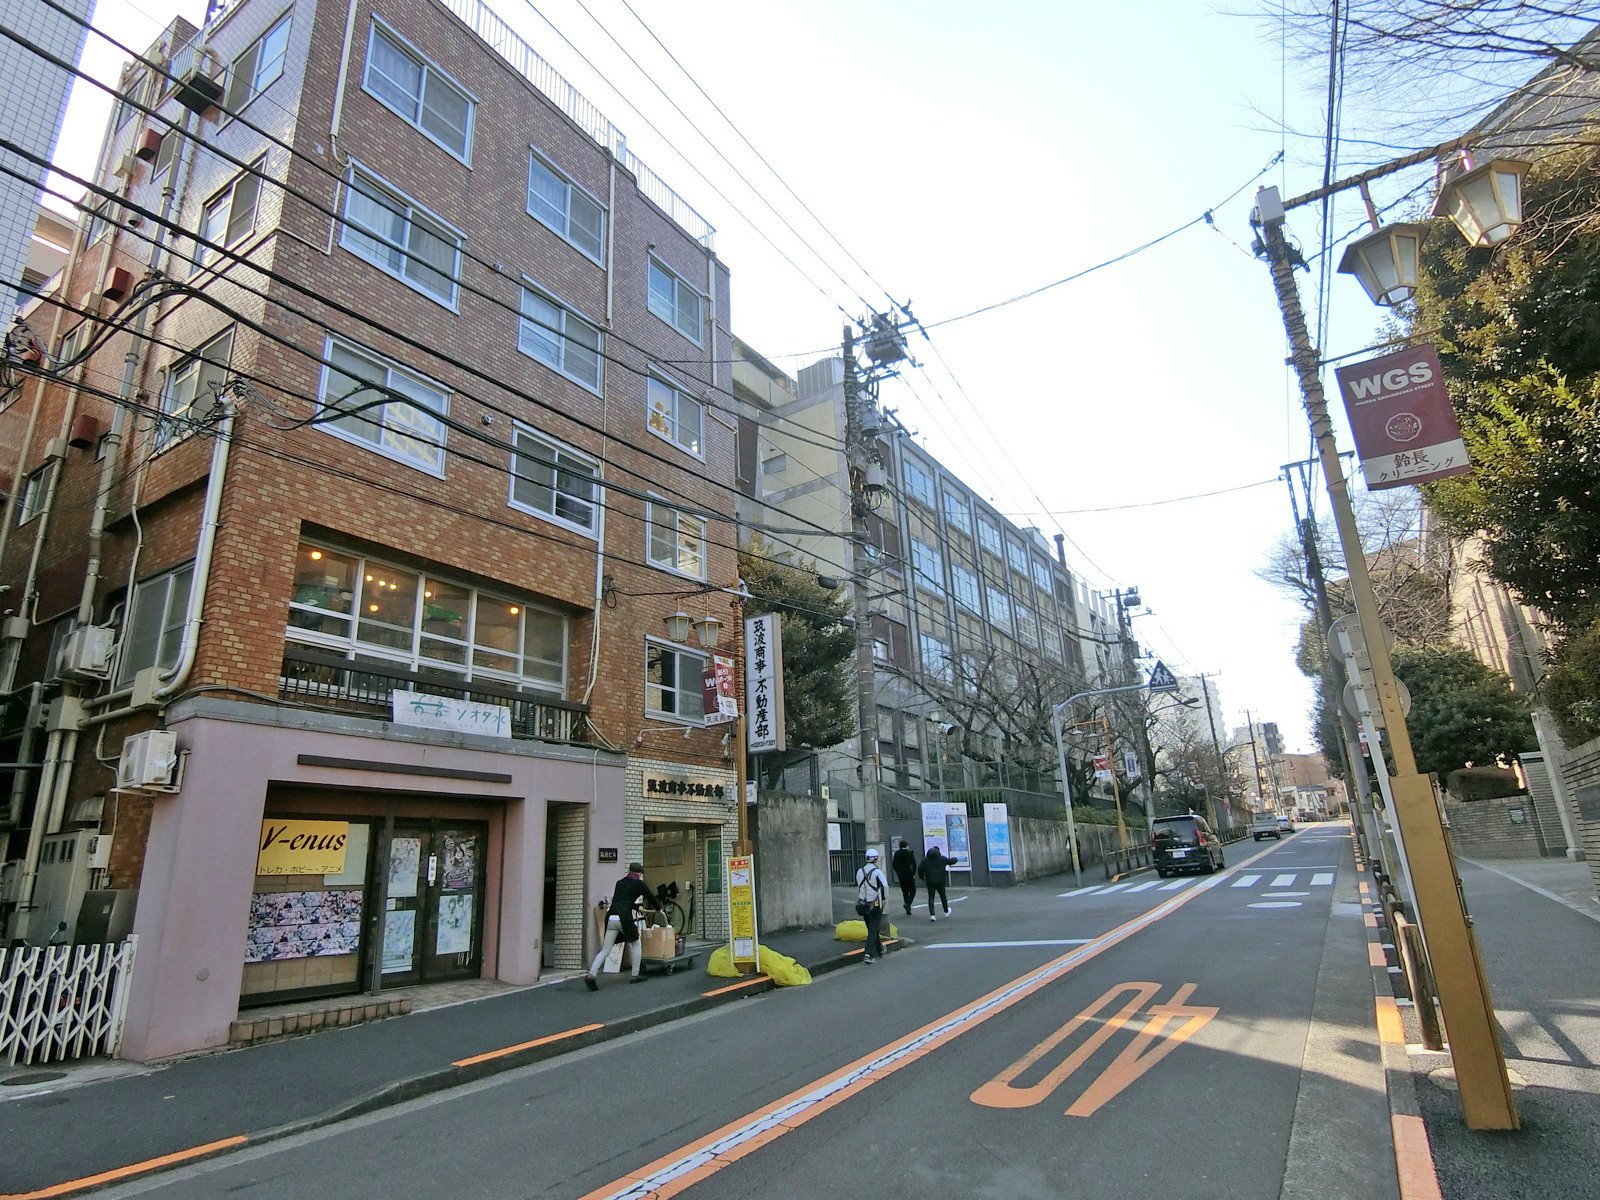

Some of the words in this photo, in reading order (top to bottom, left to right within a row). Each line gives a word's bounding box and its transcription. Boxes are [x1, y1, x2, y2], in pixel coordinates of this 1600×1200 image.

[1349, 361, 1433, 400] WGS
[1414, 382, 1435, 392] STREET
[1379, 456, 1455, 482] クリーニング
[1394, 449, 1429, 469] 鈴長
[261, 826, 347, 851] V-enus
